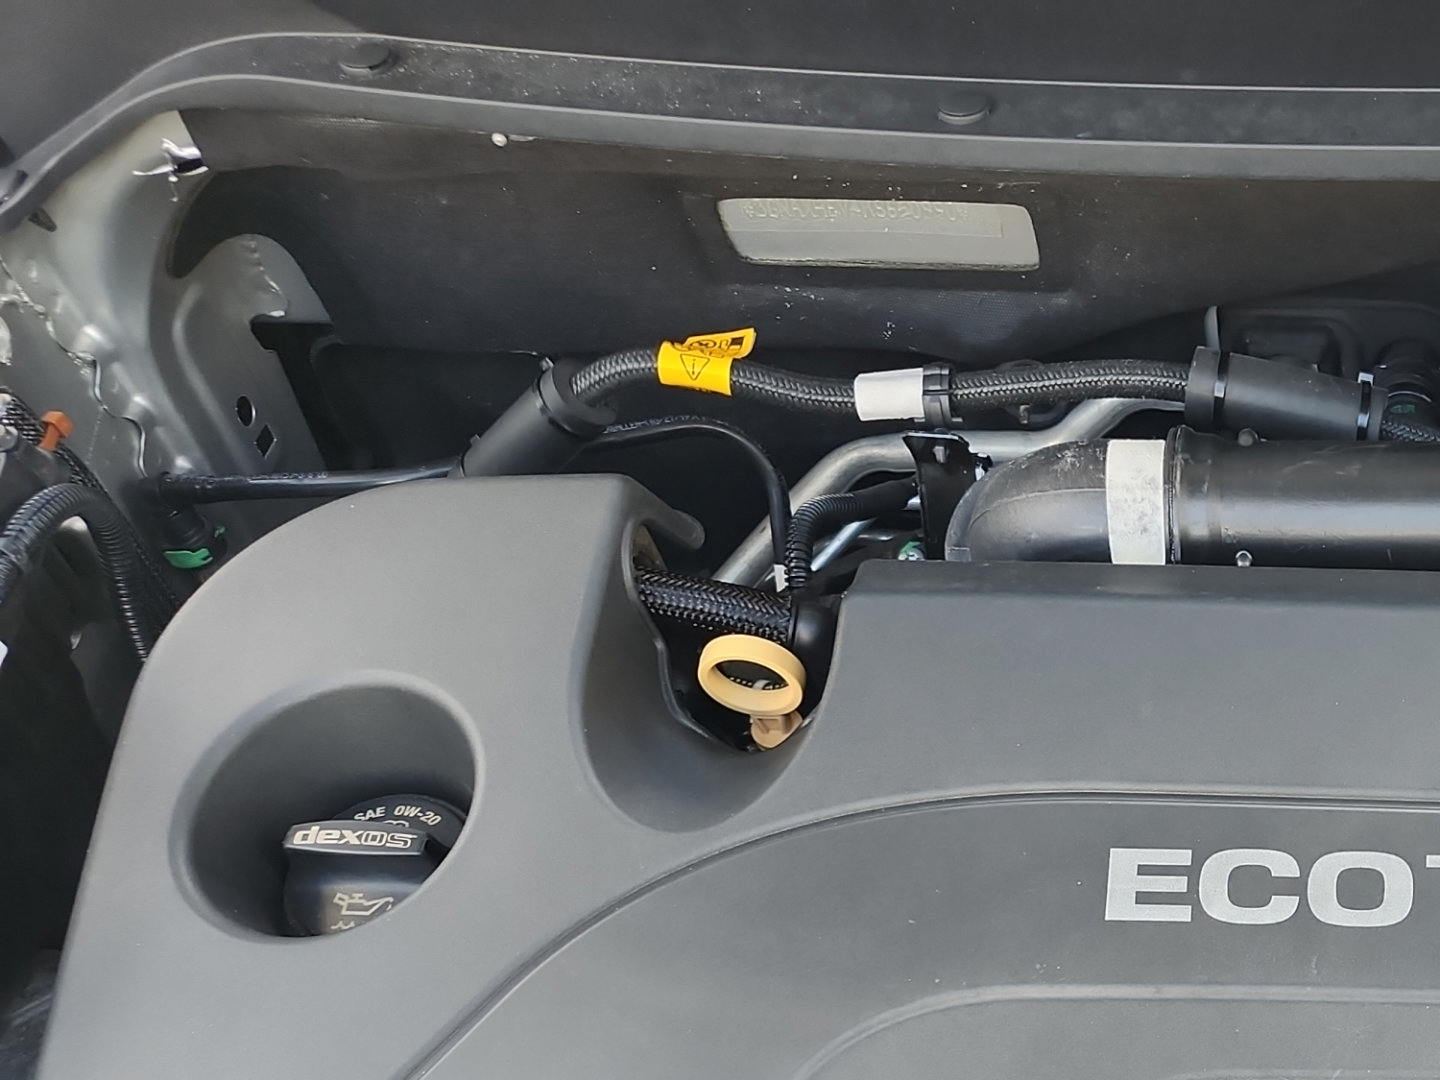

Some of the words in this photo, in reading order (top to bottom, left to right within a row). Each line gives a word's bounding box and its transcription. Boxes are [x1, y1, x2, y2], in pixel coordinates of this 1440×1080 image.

[353, 806, 386, 821] SAE
[393, 805, 442, 827] 0W-20
[293, 826, 418, 849] dexos
